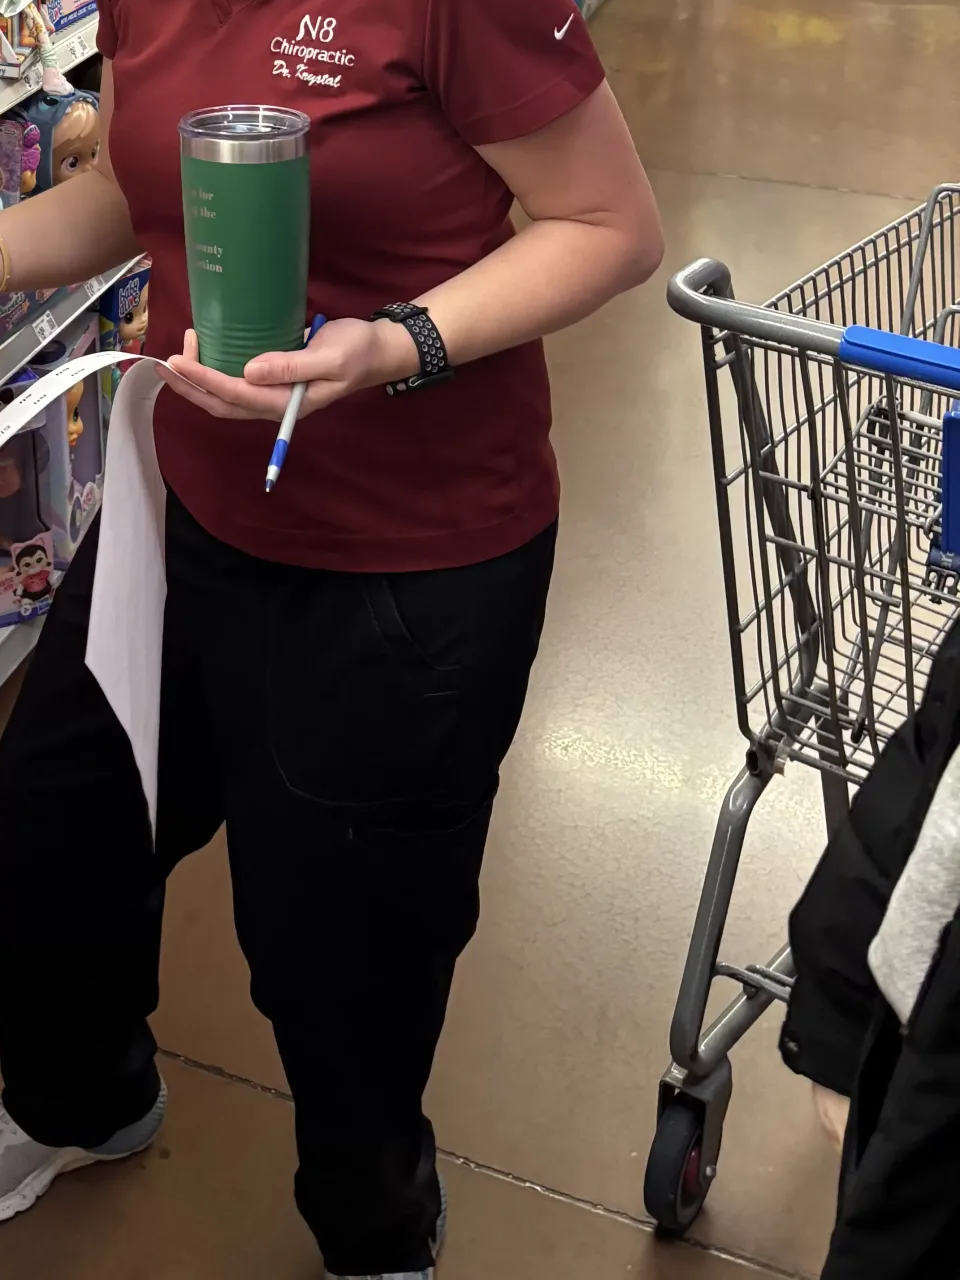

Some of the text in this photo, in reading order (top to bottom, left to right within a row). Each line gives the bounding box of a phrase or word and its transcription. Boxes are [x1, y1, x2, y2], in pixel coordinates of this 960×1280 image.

[296, 14, 337, 42] N8
[270, 36, 355, 66] Chiropractic
[295, 63, 342, 88] Krystal
[200, 207, 217, 219] the
